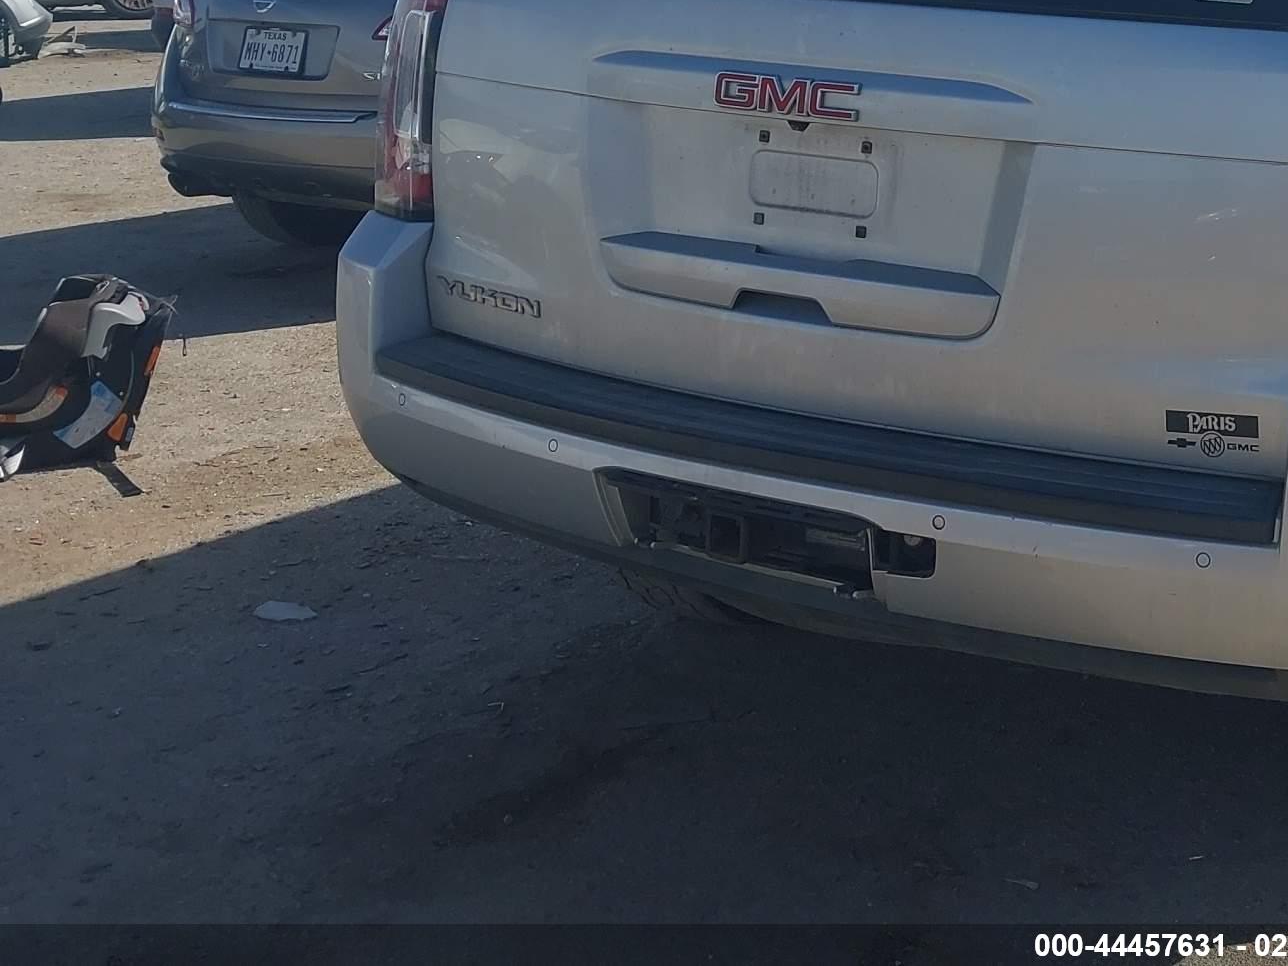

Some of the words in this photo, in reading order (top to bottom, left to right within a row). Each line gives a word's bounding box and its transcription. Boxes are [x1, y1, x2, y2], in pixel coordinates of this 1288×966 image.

[264, 32, 287, 41] TEXAS
[713, 70, 862, 121] GMC
[436, 275, 542, 319] YUKON
[1186, 413, 1236, 433] PARIS
[1227, 443, 1260, 452] GMC
